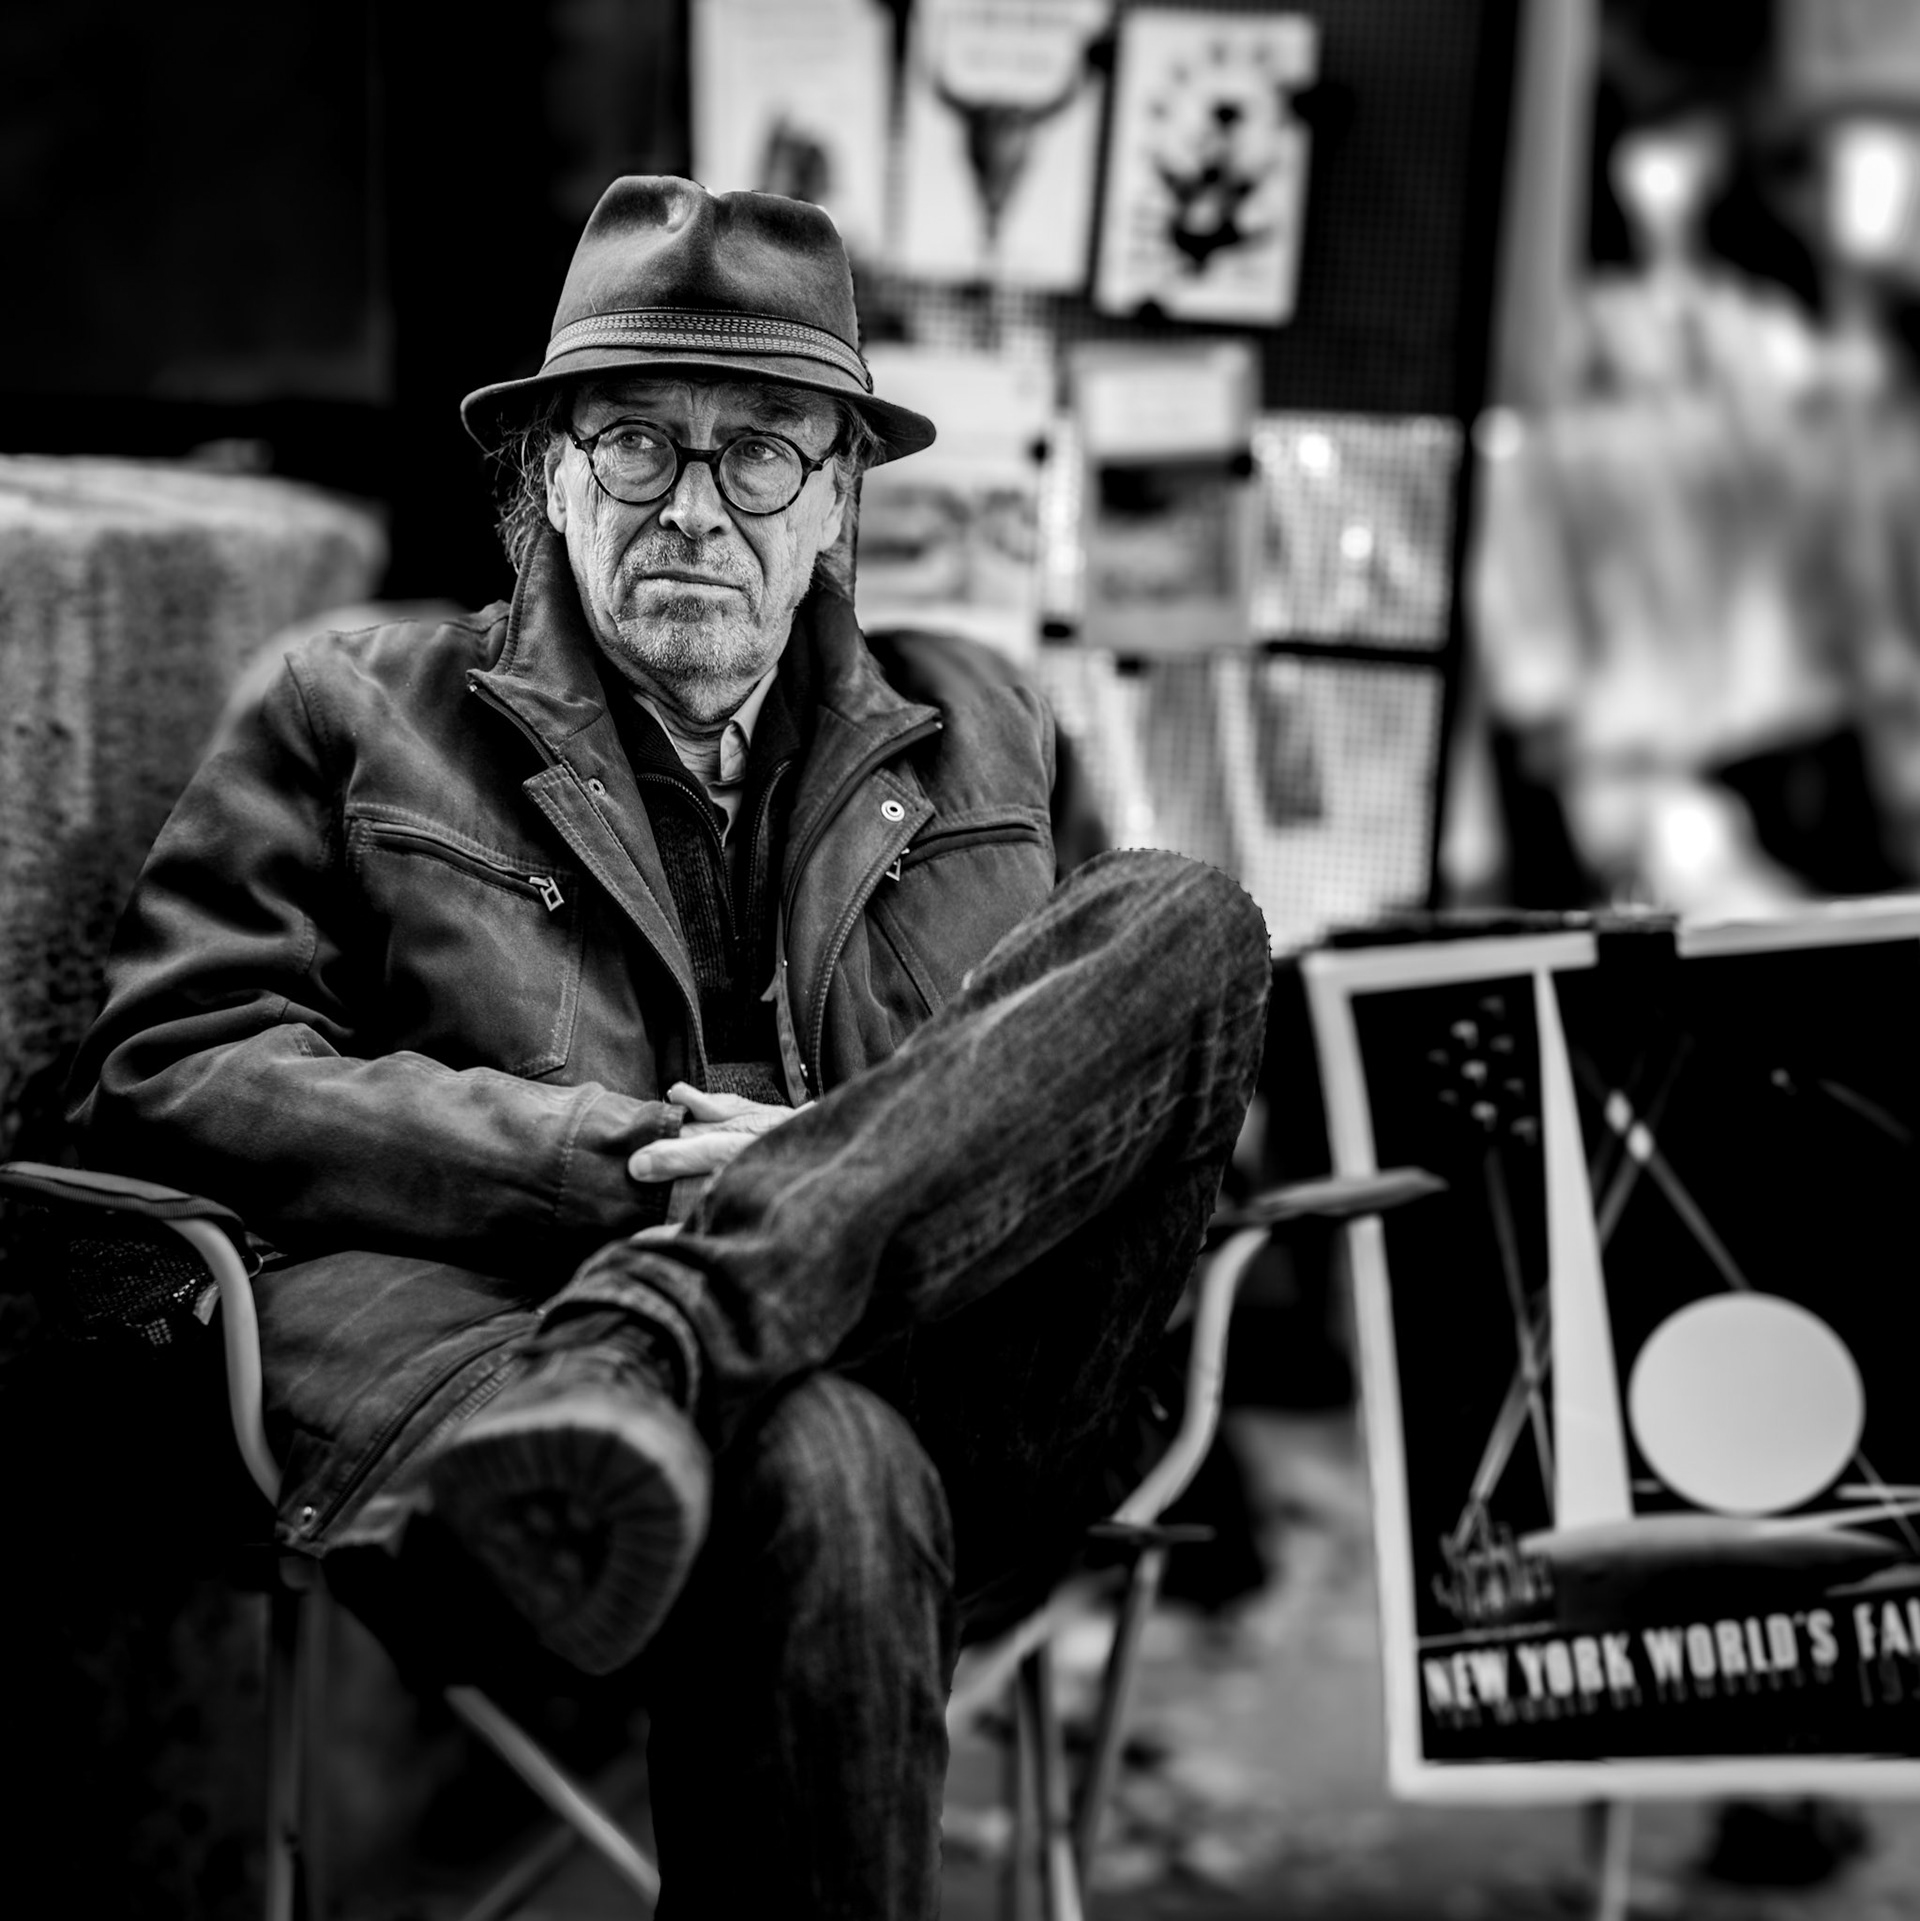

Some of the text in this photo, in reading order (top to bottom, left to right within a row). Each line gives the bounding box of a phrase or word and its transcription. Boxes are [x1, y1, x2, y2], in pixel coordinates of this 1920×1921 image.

[1424, 1649, 1508, 1709] NEW
[1517, 1633, 1636, 1699] YORK
[1643, 1608, 1839, 1684] WORLD'S
